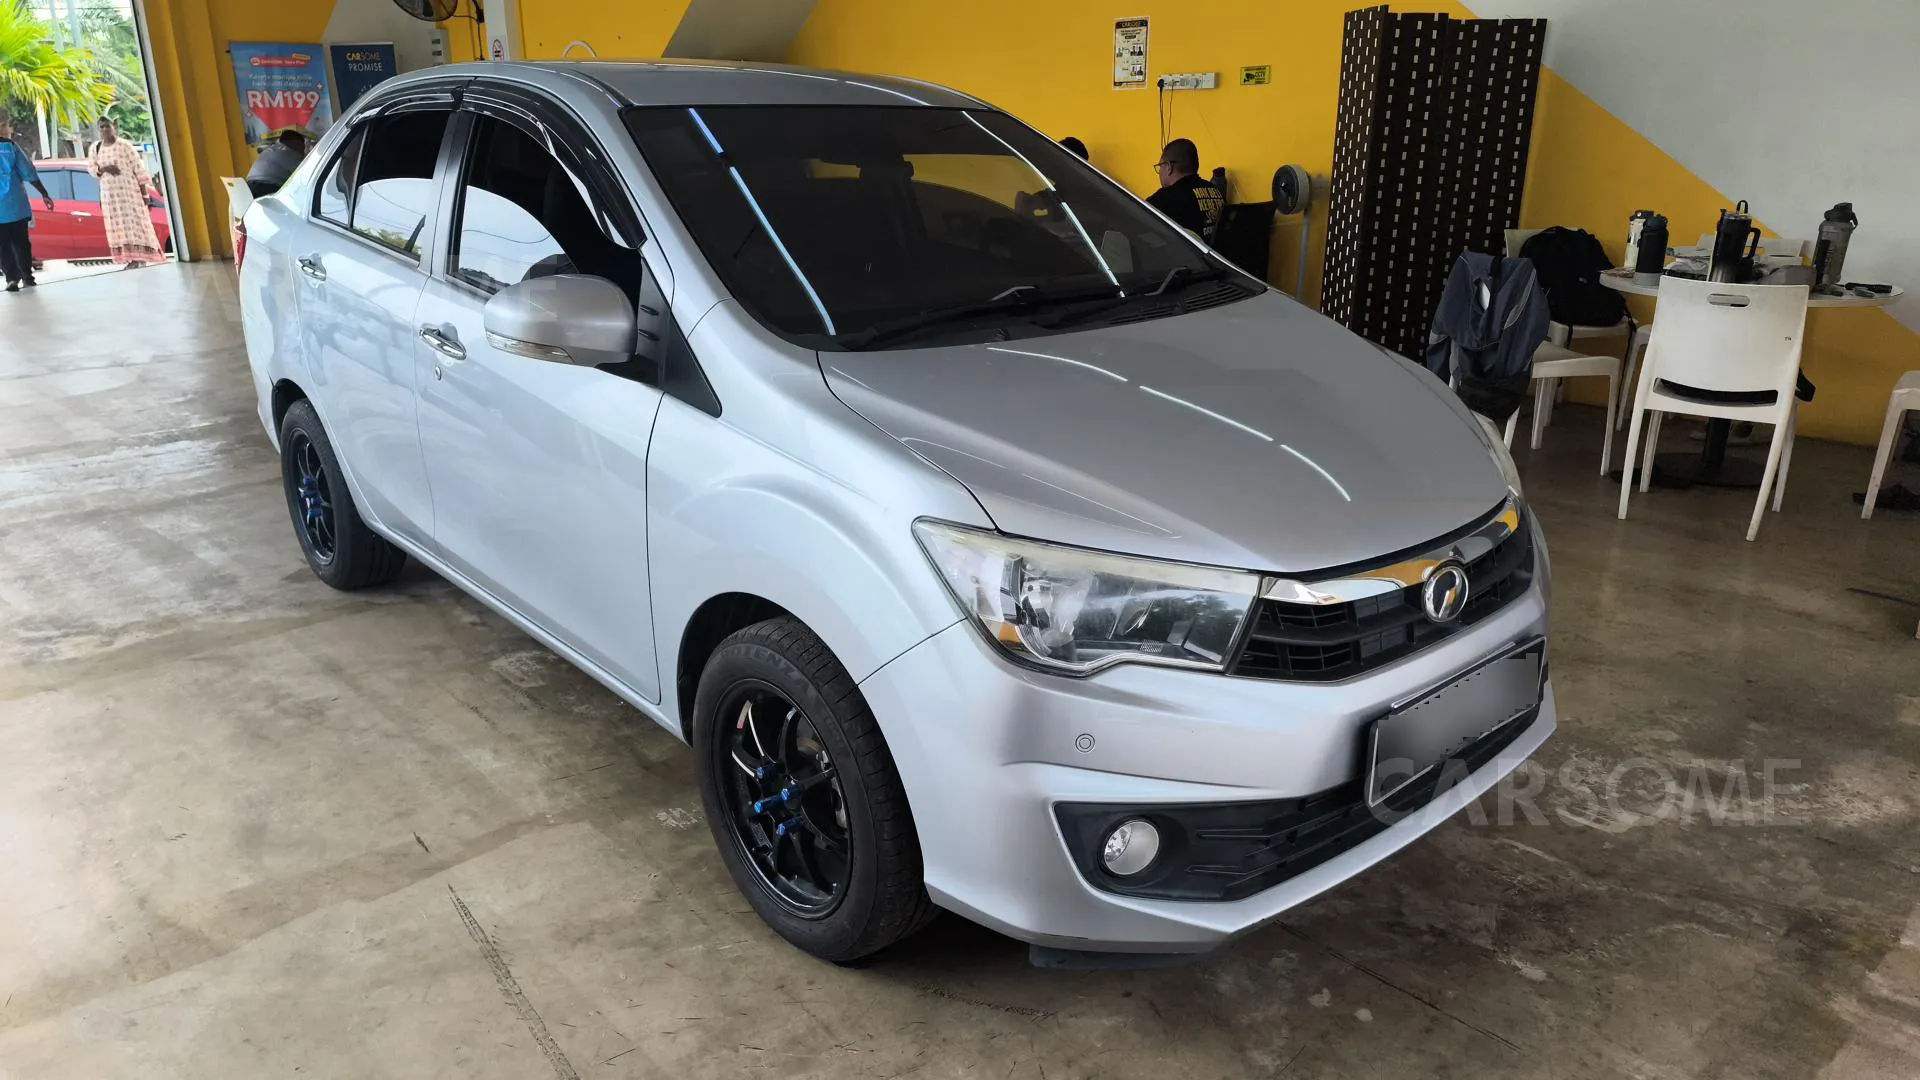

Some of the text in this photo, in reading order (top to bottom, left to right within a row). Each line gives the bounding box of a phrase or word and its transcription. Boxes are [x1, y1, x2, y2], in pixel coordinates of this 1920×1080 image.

[346, 52, 381, 61] CARSOME
[348, 63, 383, 72] PROMISE
[247, 90, 320, 109] RM199
